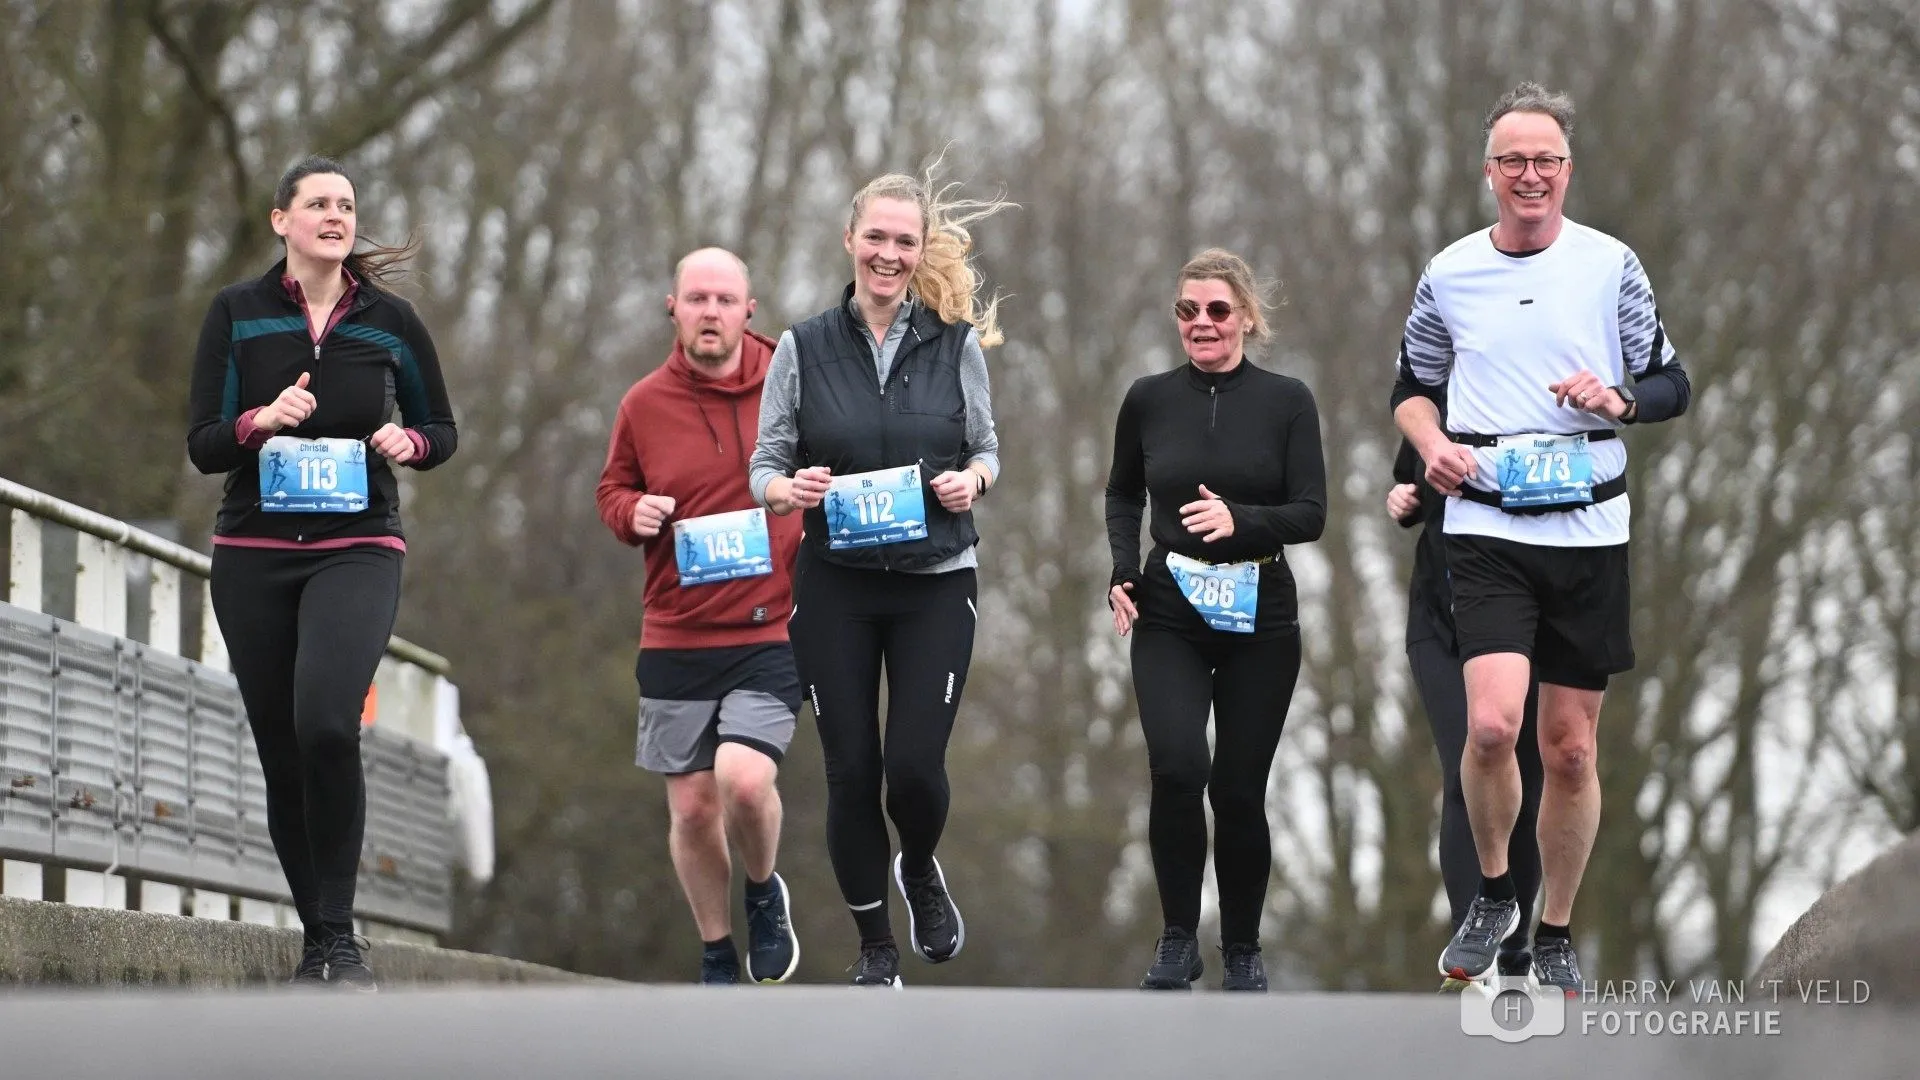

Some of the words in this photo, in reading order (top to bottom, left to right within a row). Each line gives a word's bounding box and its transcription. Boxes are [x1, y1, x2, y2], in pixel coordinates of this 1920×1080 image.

[297, 457, 338, 490] 113
[1524, 451, 1571, 483] 273
[854, 490, 895, 525] 112
[704, 529, 745, 562] 143
[1188, 575, 1235, 609] 286
[810, 684, 820, 716] FUSION
[945, 672, 954, 703] FUSION
